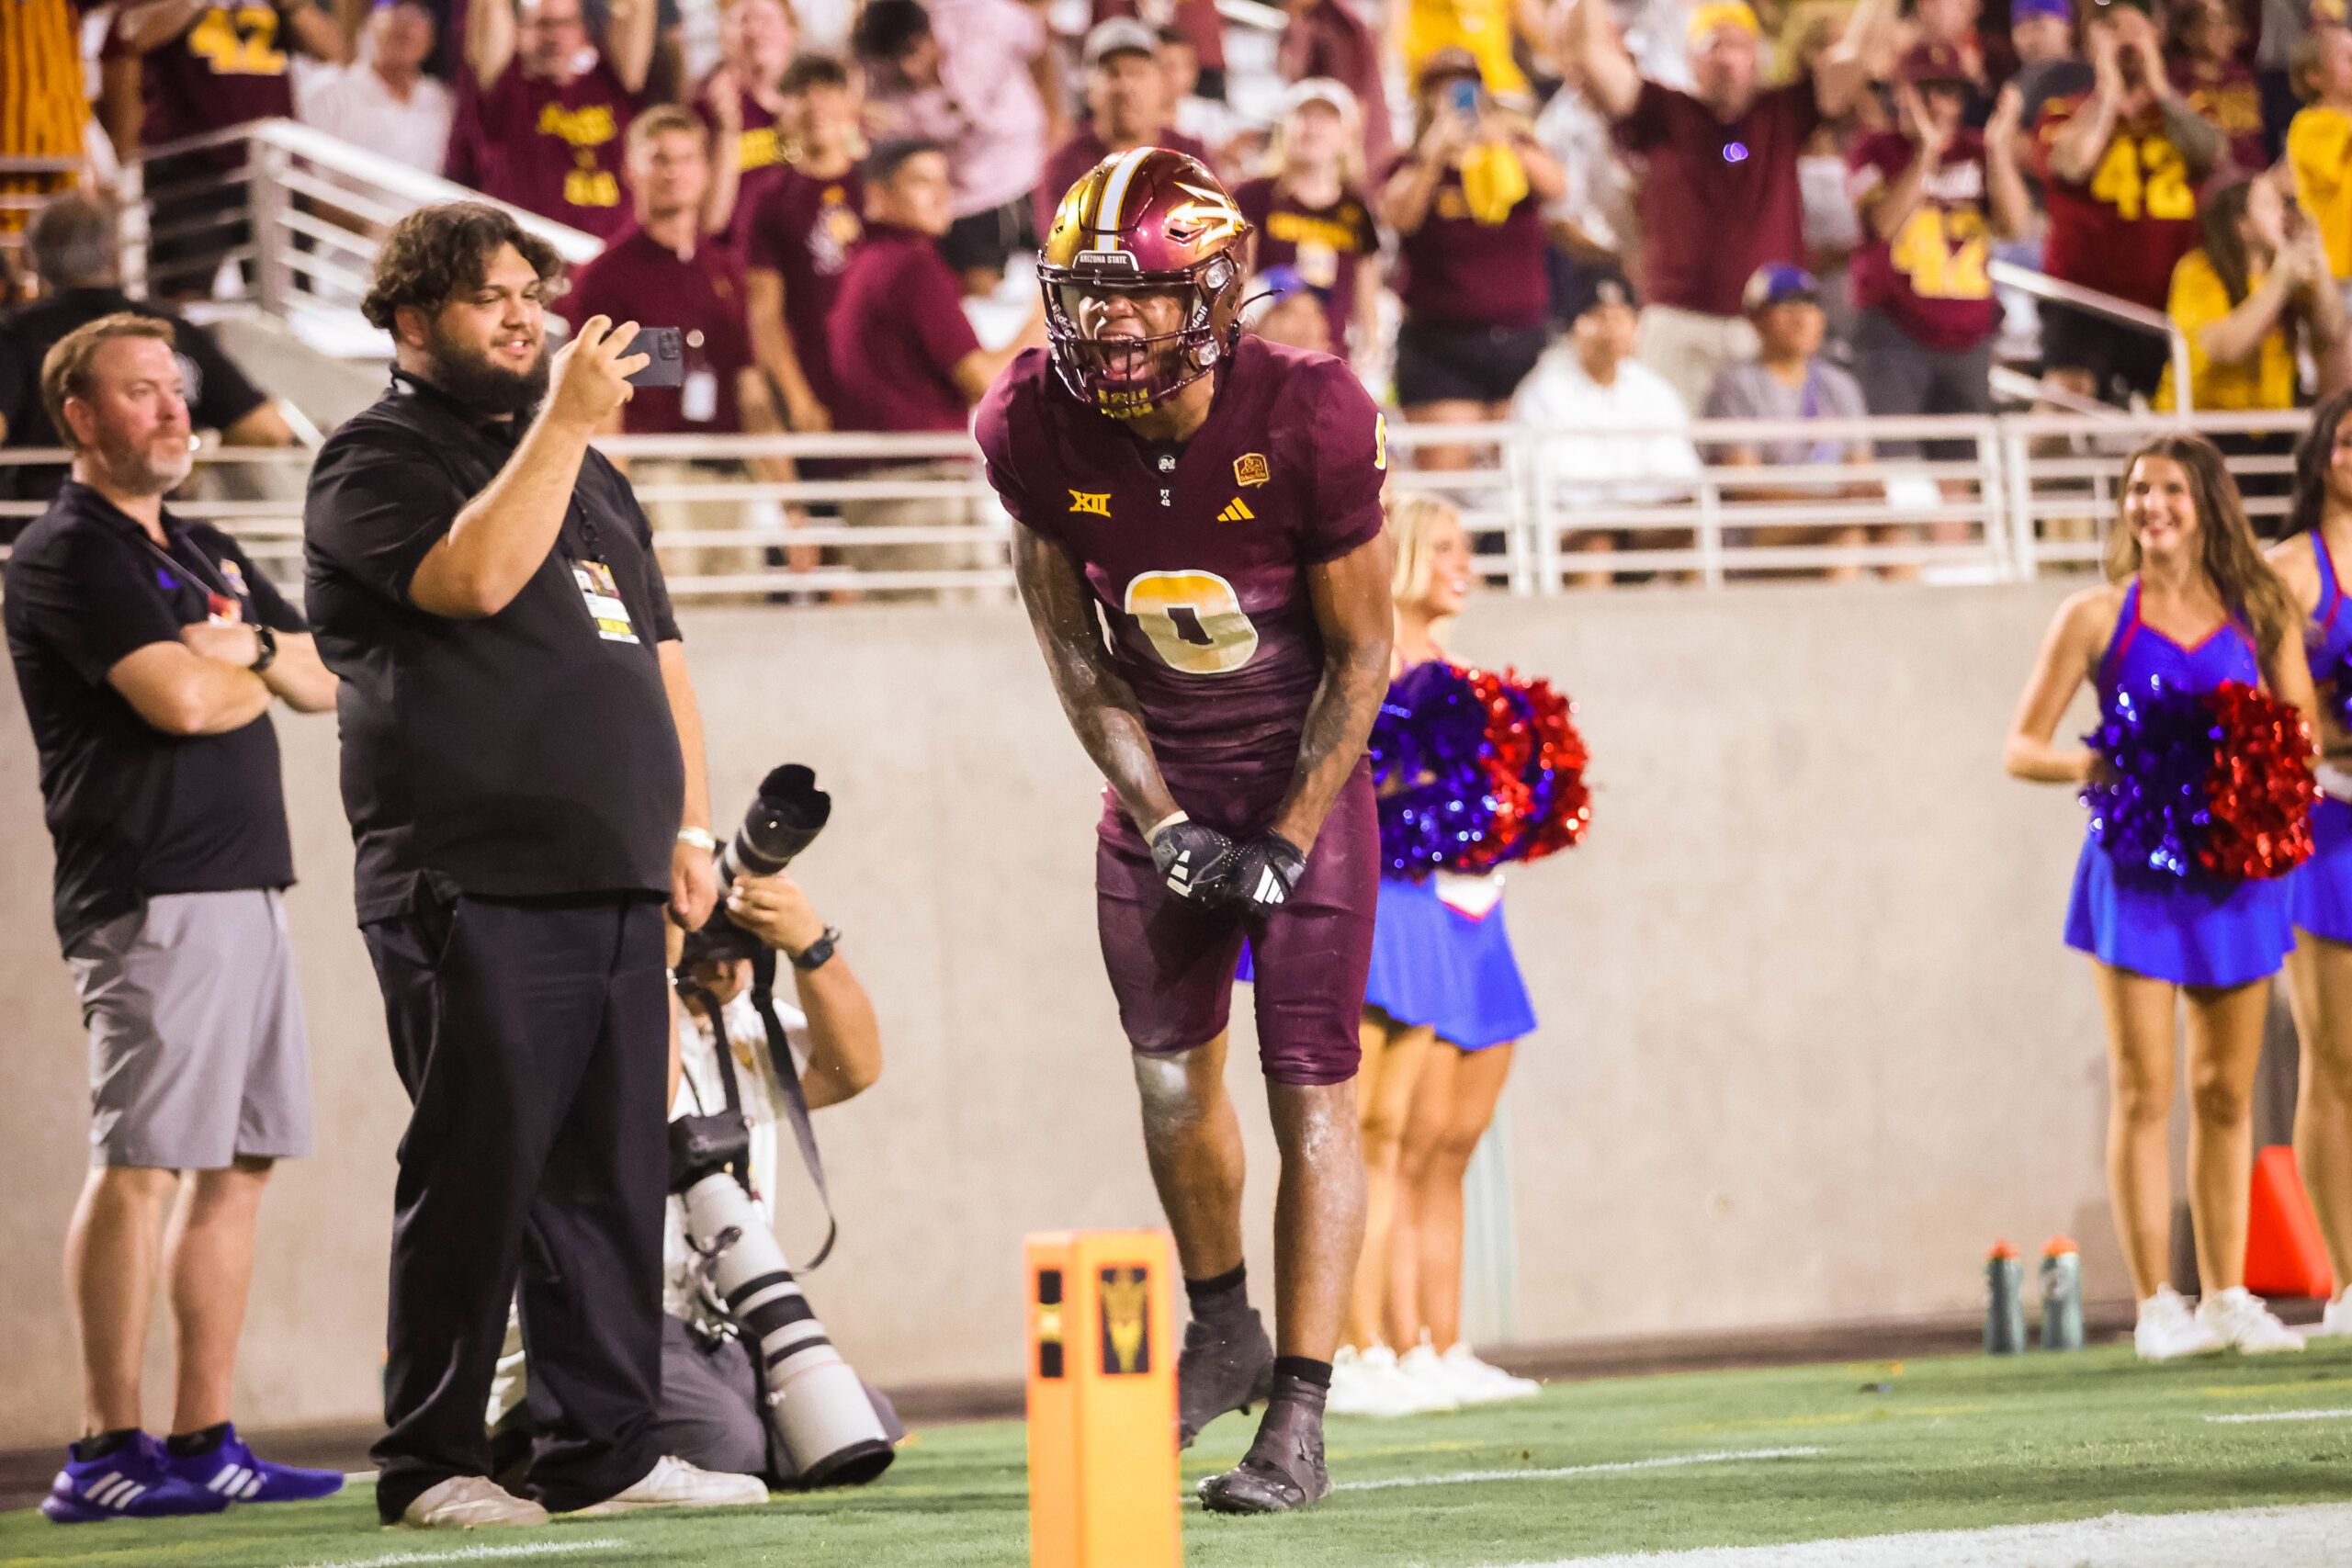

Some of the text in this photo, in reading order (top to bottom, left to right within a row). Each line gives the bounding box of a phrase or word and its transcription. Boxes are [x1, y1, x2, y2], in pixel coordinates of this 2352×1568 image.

[190, 6, 287, 74] 42
[2091, 135, 2197, 220] 42
[1080, 254, 1127, 265] ARIZONA STATE
[1891, 205, 1992, 299] 42
[1192, 305, 1208, 329] dell
[1068, 489, 1112, 518] XII
[1159, 489, 1170, 497] PT
[1125, 569, 1259, 674] 0
